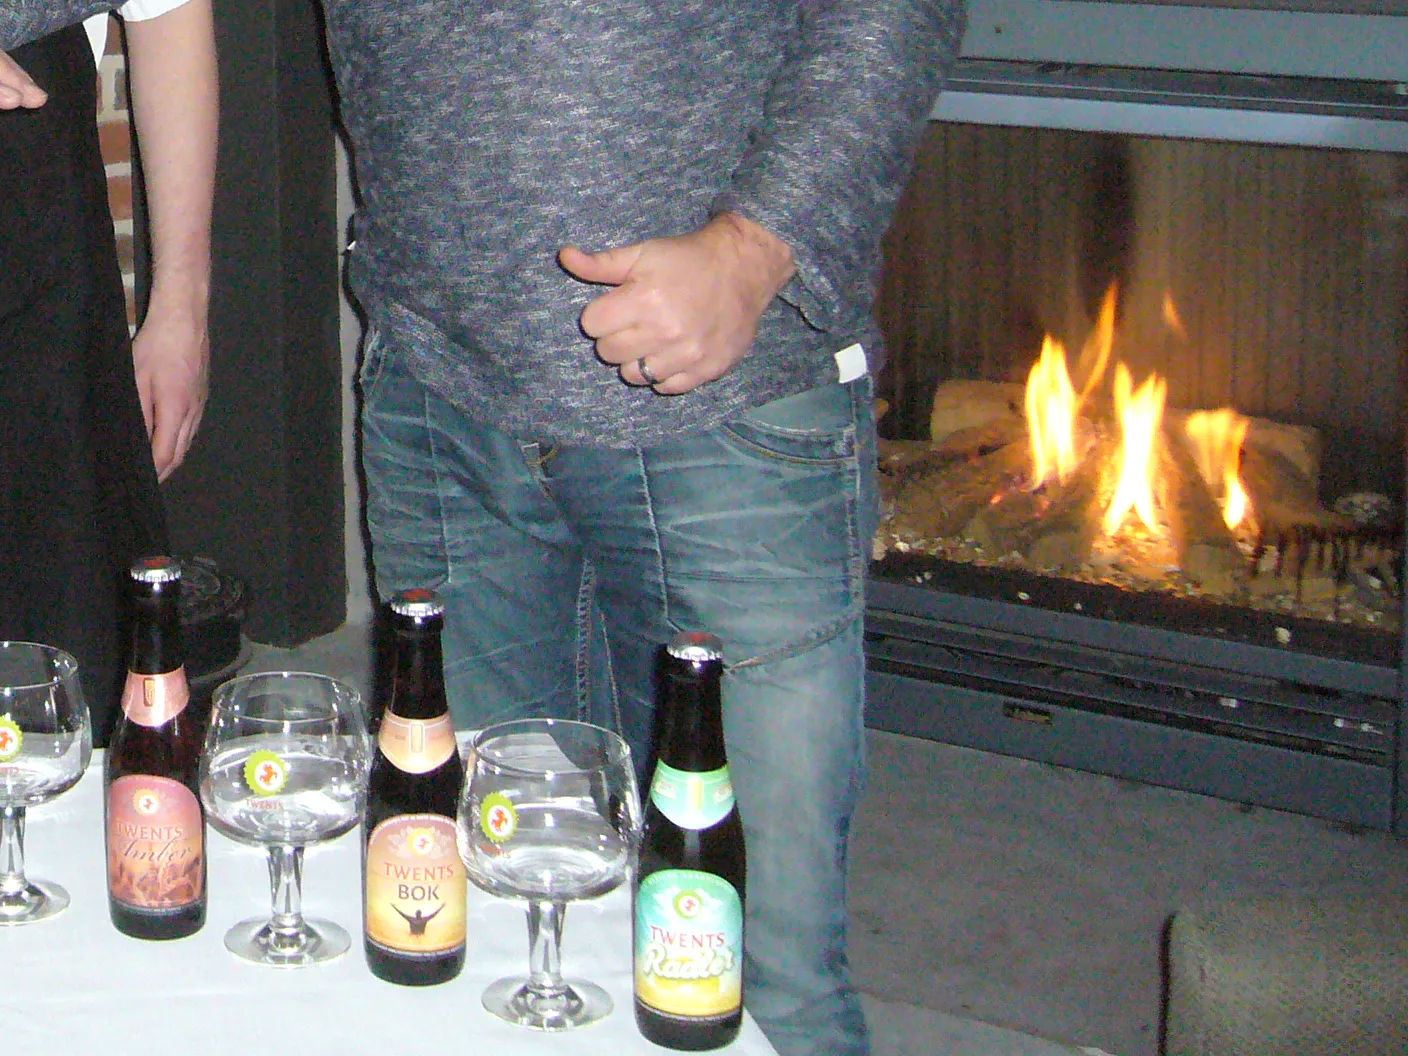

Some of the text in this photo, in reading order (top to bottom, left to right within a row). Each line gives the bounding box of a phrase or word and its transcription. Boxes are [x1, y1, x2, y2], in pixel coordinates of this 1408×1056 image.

[116, 819, 184, 841] TWENTS
[383, 862, 454, 881] TWENTS
[397, 884, 440, 901] BOK
[650, 925, 726, 948] TWENTS
[643, 942, 736, 980] Radler
